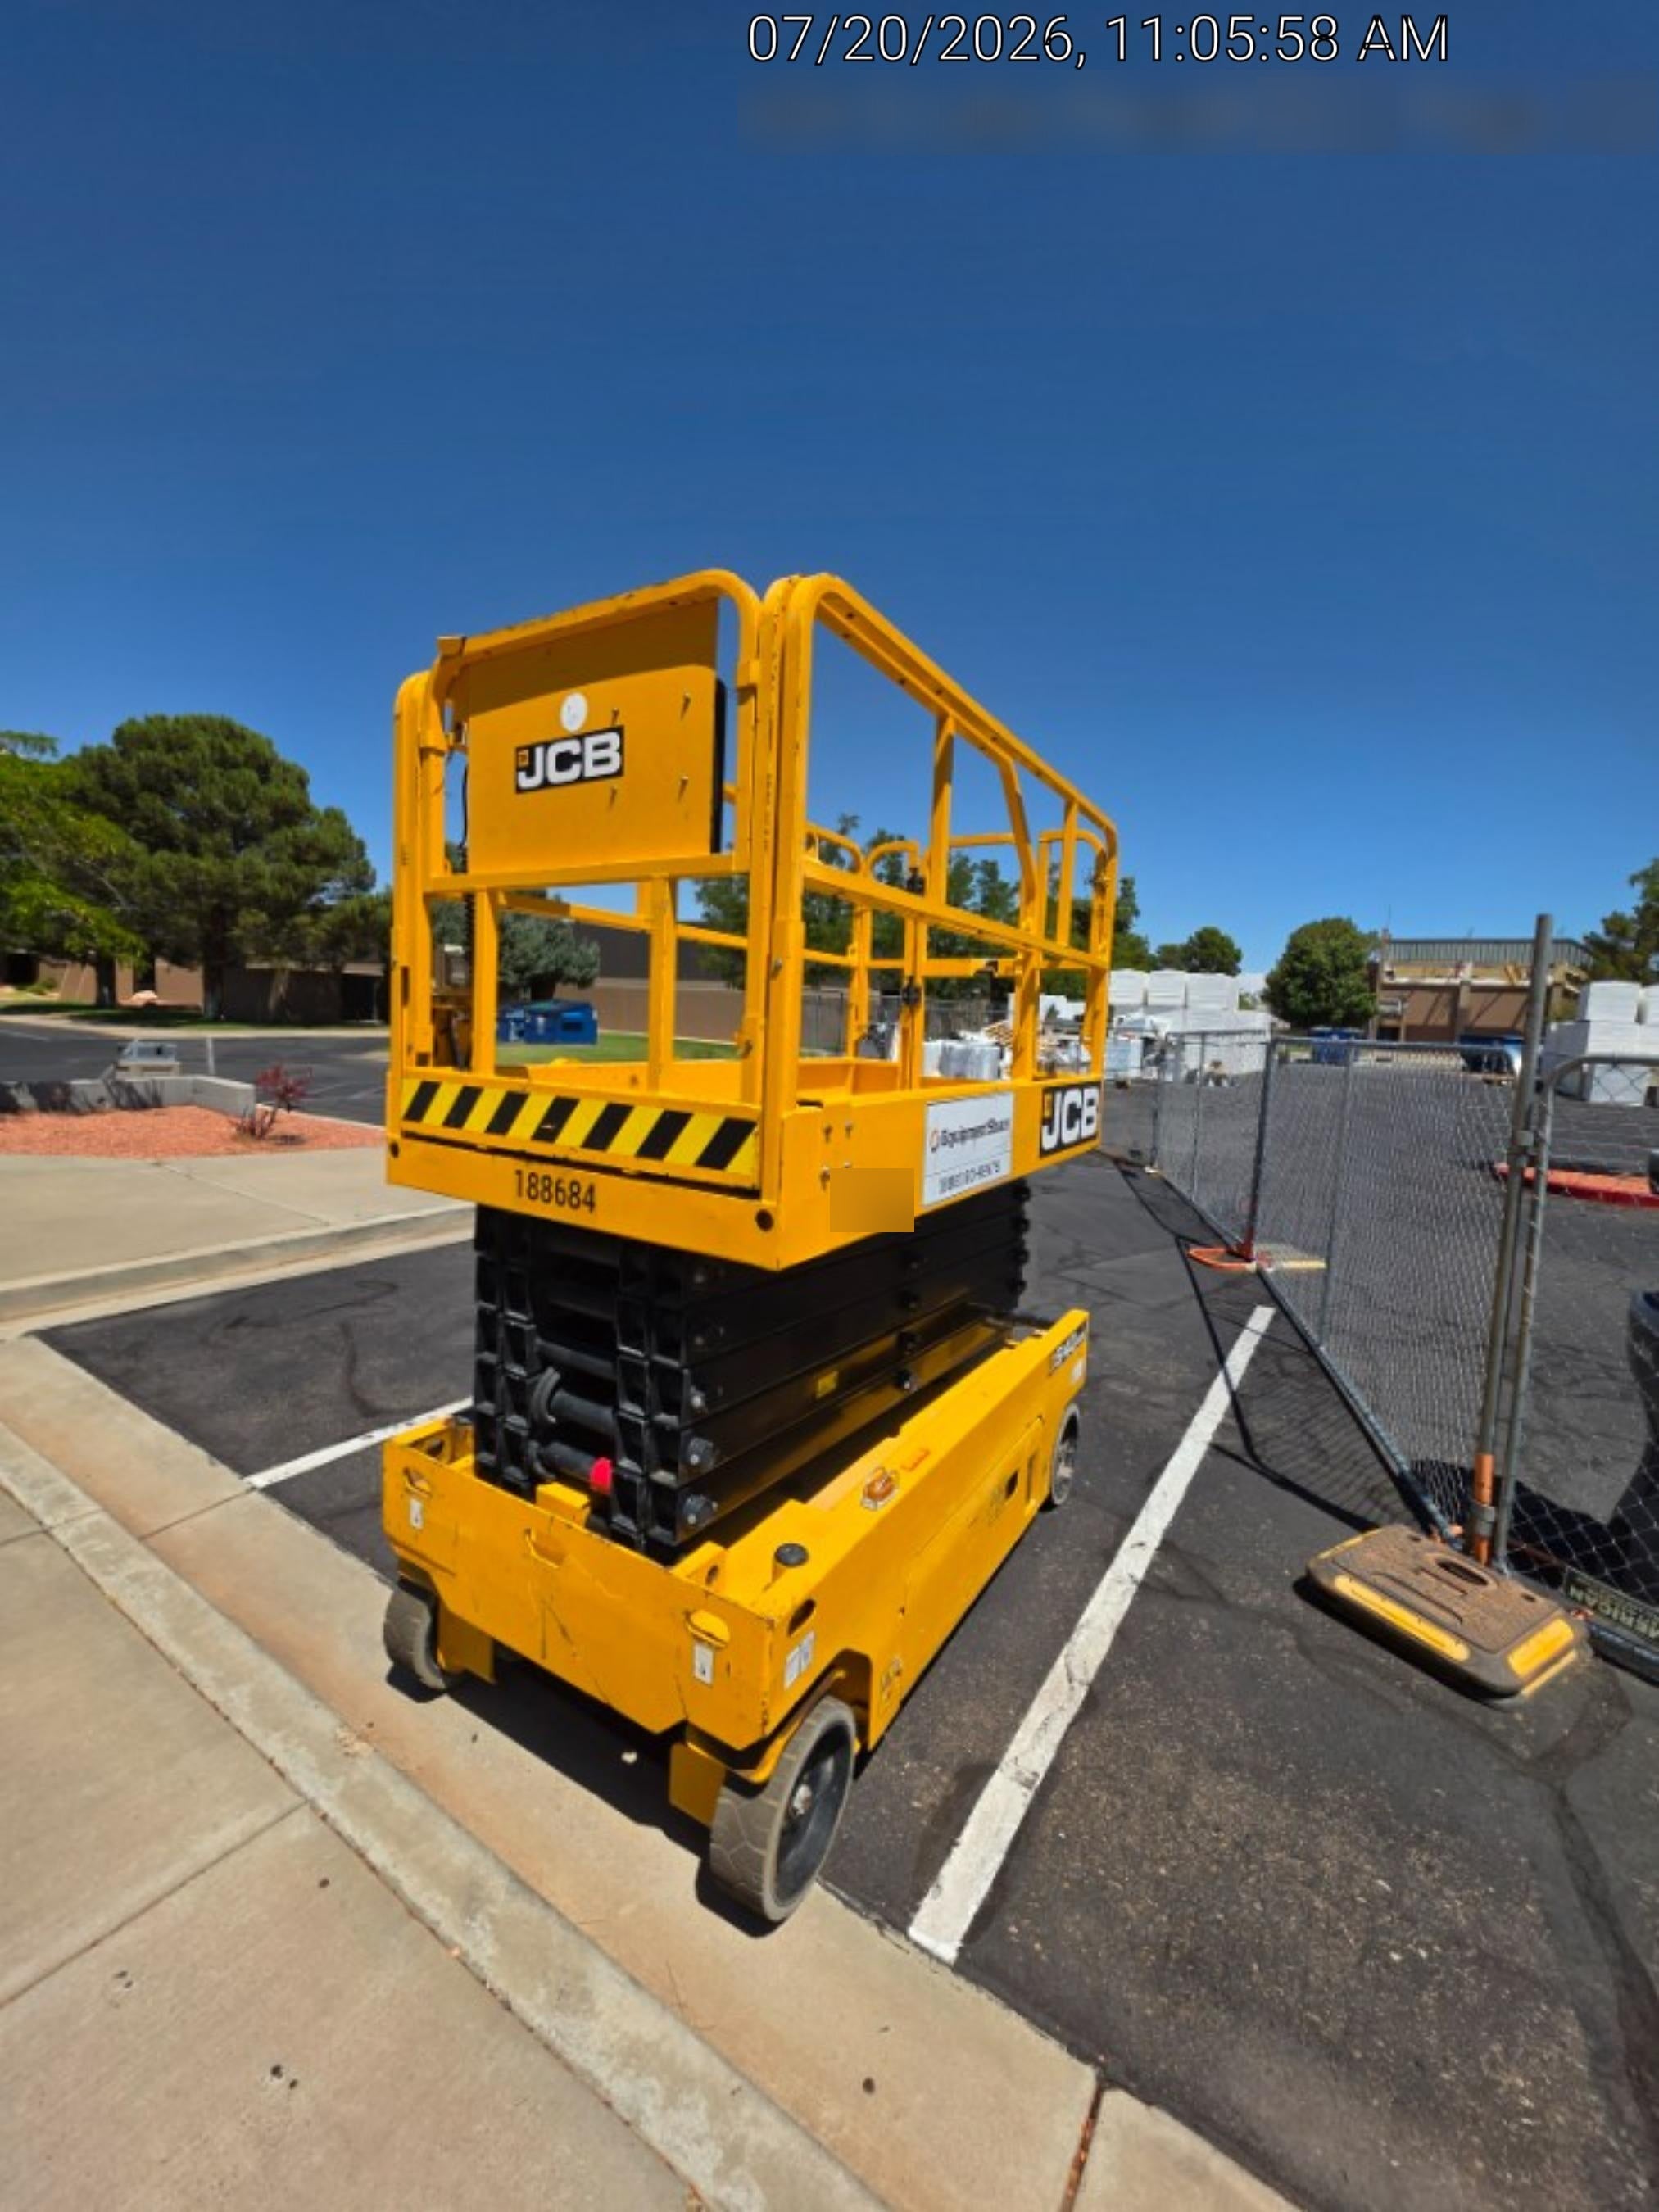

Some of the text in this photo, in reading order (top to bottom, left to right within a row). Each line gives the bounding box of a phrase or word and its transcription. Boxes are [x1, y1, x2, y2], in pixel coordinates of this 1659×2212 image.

[517, 731, 622, 790] JCB
[1040, 1086, 1099, 1151] JCB
[514, 1168, 596, 1214] 188684
